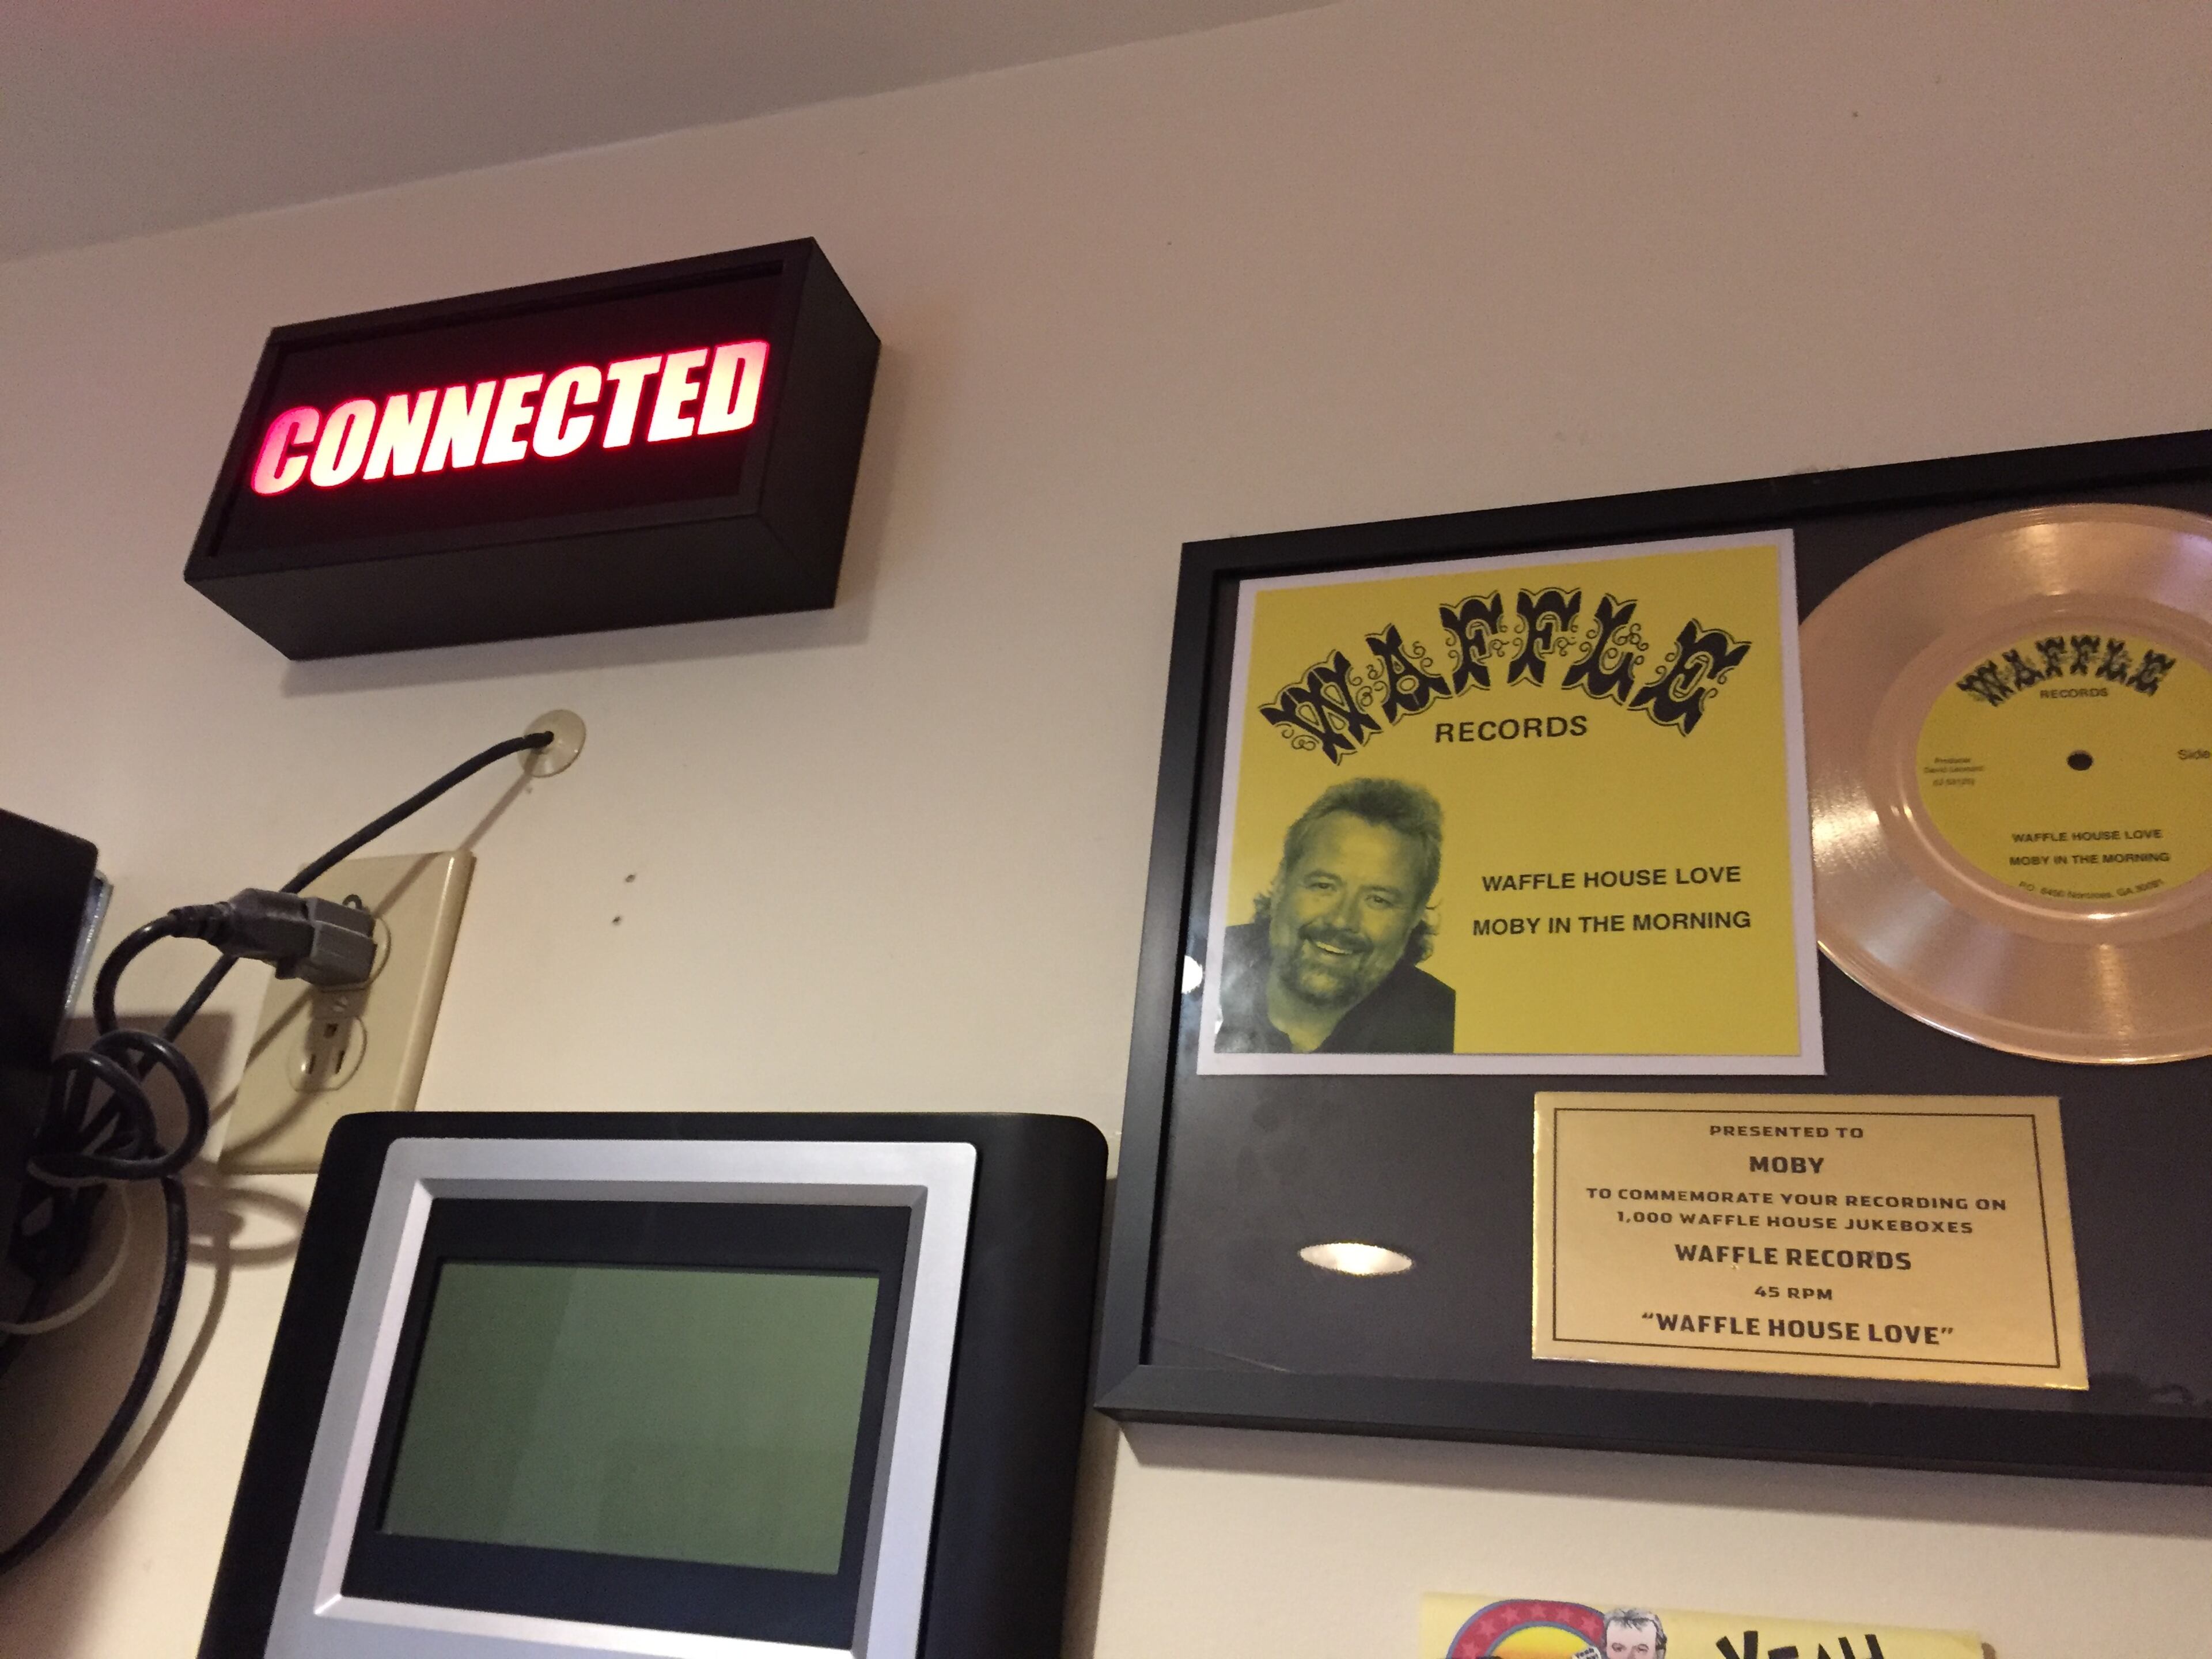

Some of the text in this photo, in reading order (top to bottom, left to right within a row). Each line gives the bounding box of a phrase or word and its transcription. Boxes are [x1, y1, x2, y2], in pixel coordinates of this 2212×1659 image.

[250, 339, 770, 497] CONNECTED
[1258, 586, 1752, 766] WAFFLE
[1956, 634, 2177, 707] WAFFLE
[2039, 687, 2109, 700] RECORDS
[1434, 714, 1589, 745] RECORDS
[2177, 749, 2210, 760] Side
[2012, 829, 2164, 844] WAFFLE HOUSE LOVE
[2009, 852, 2171, 867] MOBY IN THE MORNING
[1482, 866, 1742, 893] WAFFLE HOUSE LOVE
[1473, 910, 1752, 937] MOBY IN THE MORNING
[1709, 1125, 1865, 1139] PRESENTED TO
[1749, 1156, 1825, 1175] MOBY
[1586, 1187, 2007, 1211] TO COMMEMORATE YOUR RECORDING ON
[1617, 1211, 1974, 1235] 1,000 WAFFLE HOUSE JUKEBOXES
[1675, 1244, 1912, 1271] WAFFLE RECORDS
[1754, 1286, 1834, 1301] 45 RPM
[1641, 1312, 1955, 1346] “WAFFLE HOUSE LOVE”
